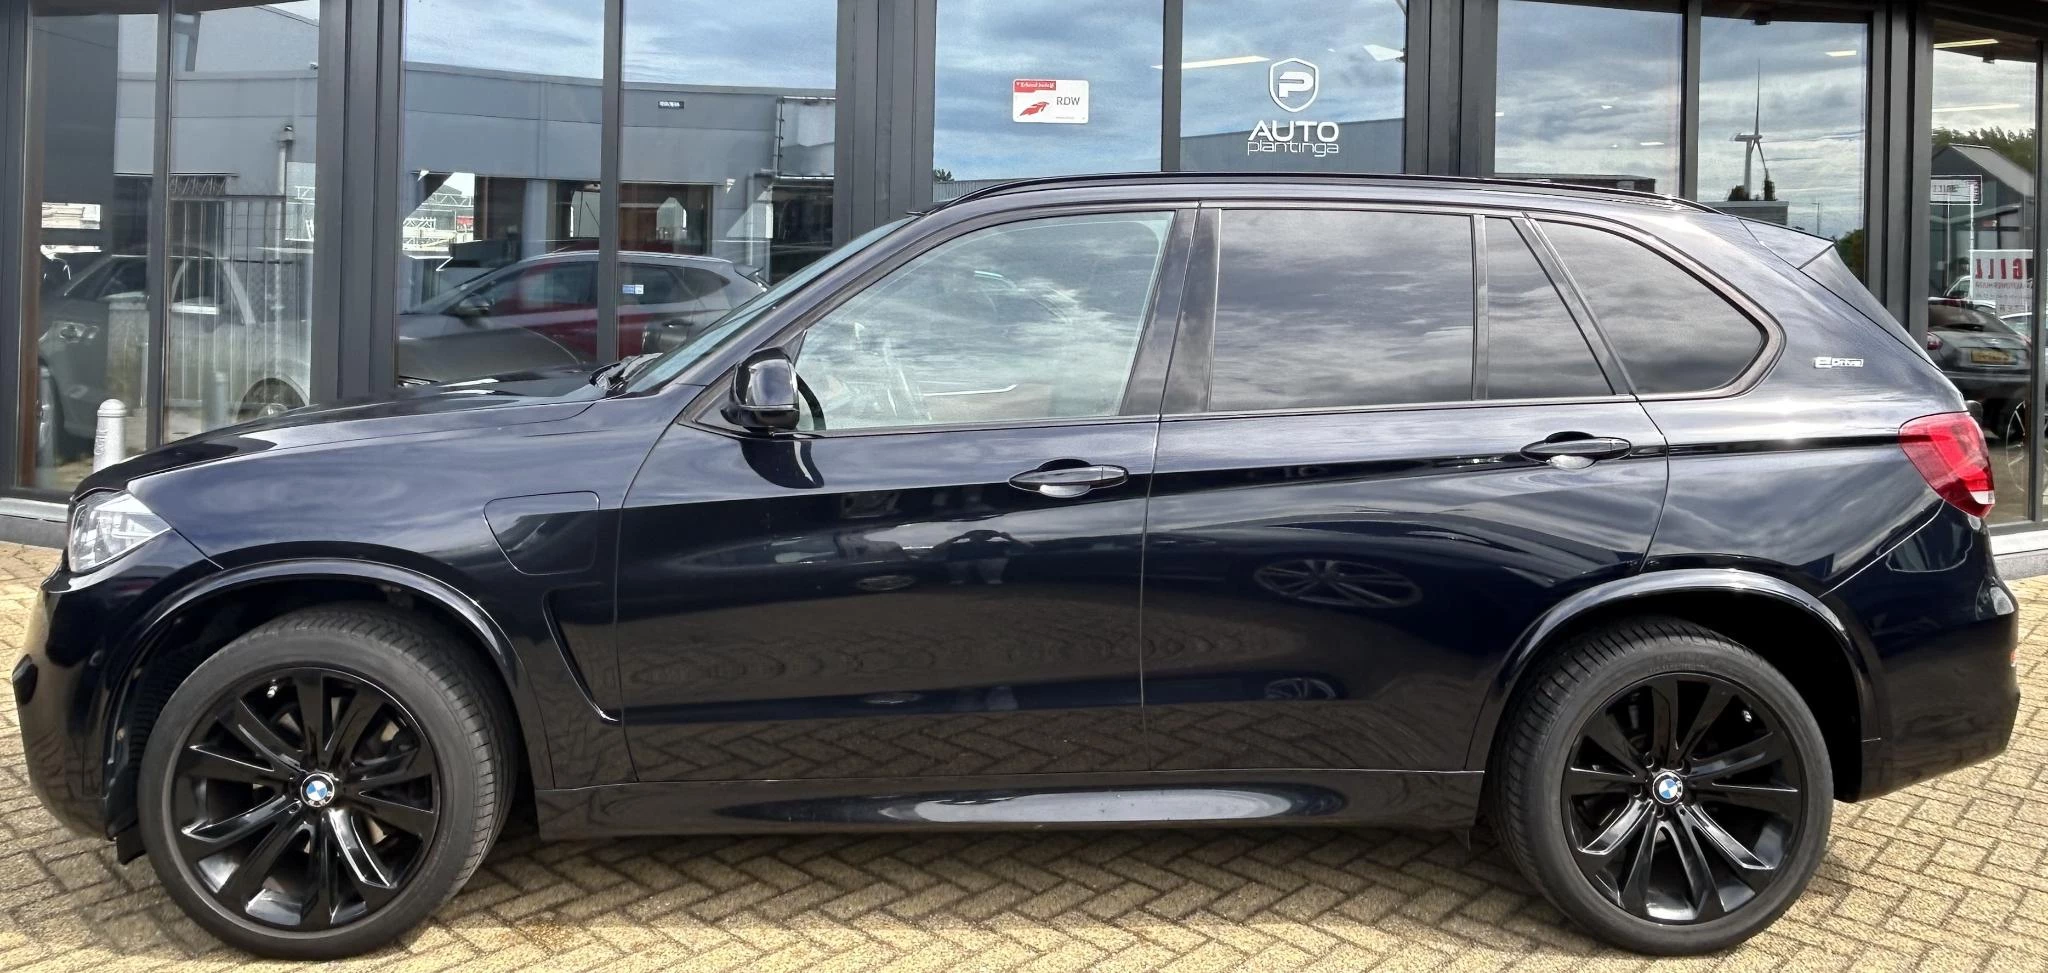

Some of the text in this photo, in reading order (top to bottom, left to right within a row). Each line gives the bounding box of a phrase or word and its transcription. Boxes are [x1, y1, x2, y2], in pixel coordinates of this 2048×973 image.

[1056, 96, 1081, 106] RDW
[1247, 119, 1340, 143] AUTO
[1247, 140, 1340, 157] plantinga
